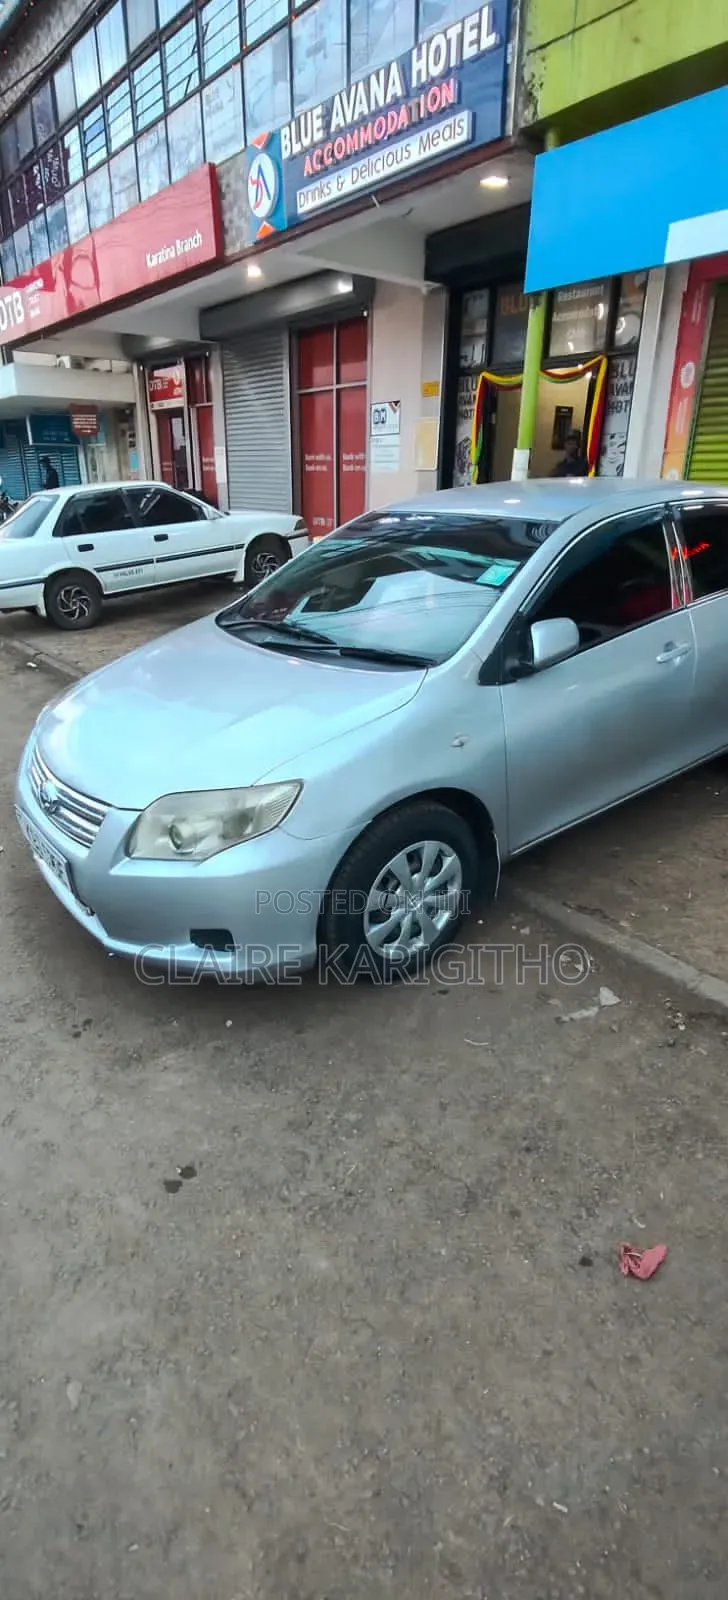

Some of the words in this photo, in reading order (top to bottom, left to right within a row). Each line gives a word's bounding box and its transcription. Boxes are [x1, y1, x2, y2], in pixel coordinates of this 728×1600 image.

[281, 107, 324, 160] BLUE
[331, 61, 403, 132] AVANA
[411, 5, 498, 87] HOTEL
[303, 78, 458, 177] ACCOMMODATION
[298, 178, 332, 208] Drinks
[336, 174, 346, 191] &
[351, 143, 412, 186] Delicious
[418, 117, 465, 153] Meals
[145, 244, 175, 268] Karatina
[175, 229, 202, 256] Branch
